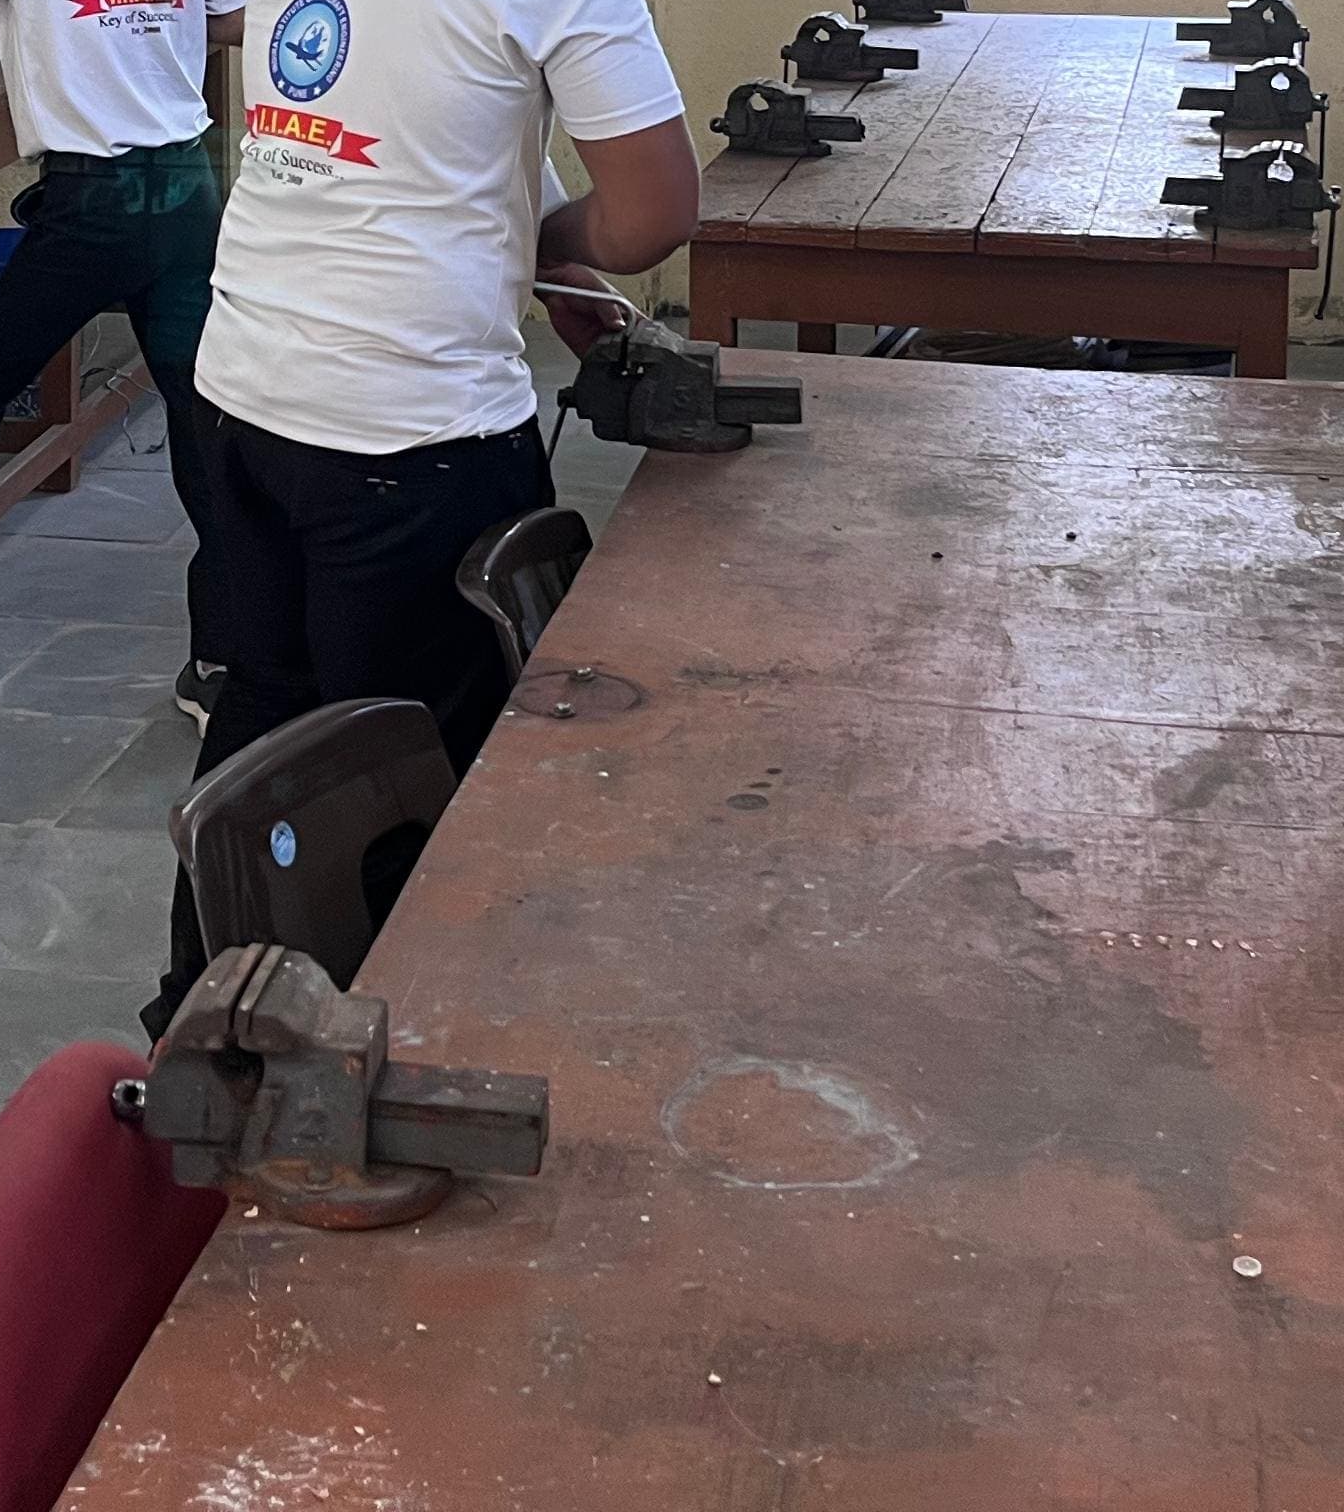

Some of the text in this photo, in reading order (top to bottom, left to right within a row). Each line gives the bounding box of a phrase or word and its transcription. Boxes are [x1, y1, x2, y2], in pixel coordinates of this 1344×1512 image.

[97, 15, 122, 28] Key
[125, 10, 137, 24] of
[258, 107, 332, 147] I.I.A.E.
[263, 147, 280, 164] of
